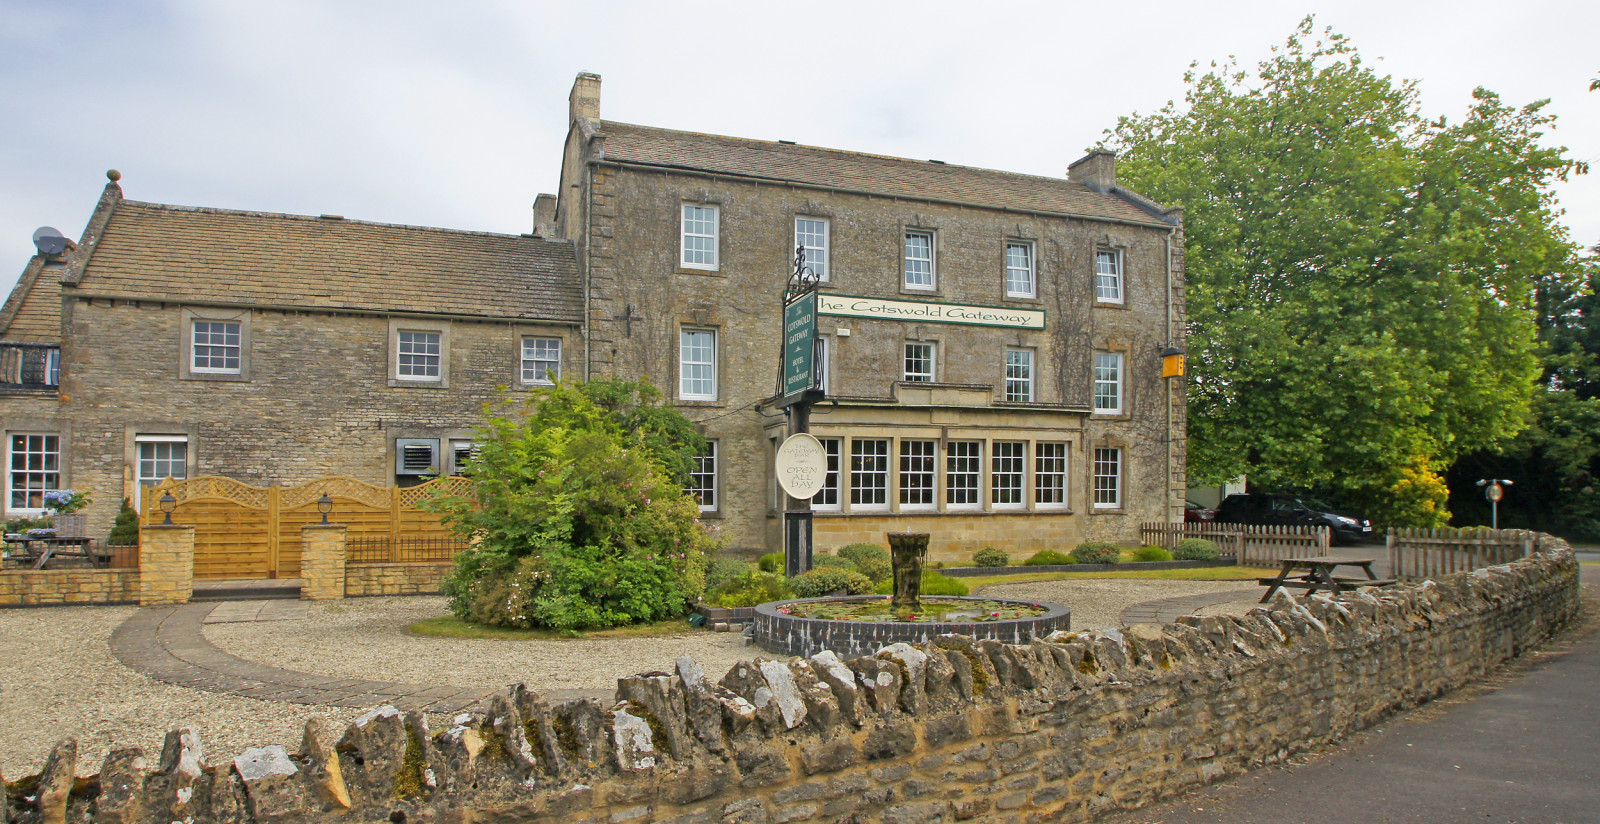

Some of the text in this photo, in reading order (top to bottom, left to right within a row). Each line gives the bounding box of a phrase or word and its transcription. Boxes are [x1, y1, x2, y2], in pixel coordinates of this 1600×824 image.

[850, 301, 942, 317] Cotswold
[946, 308, 1031, 325] Gateway
[788, 314, 811, 332] COTSWOLD
[789, 329, 808, 344] GATEWAY
[791, 481, 814, 489] DAY
